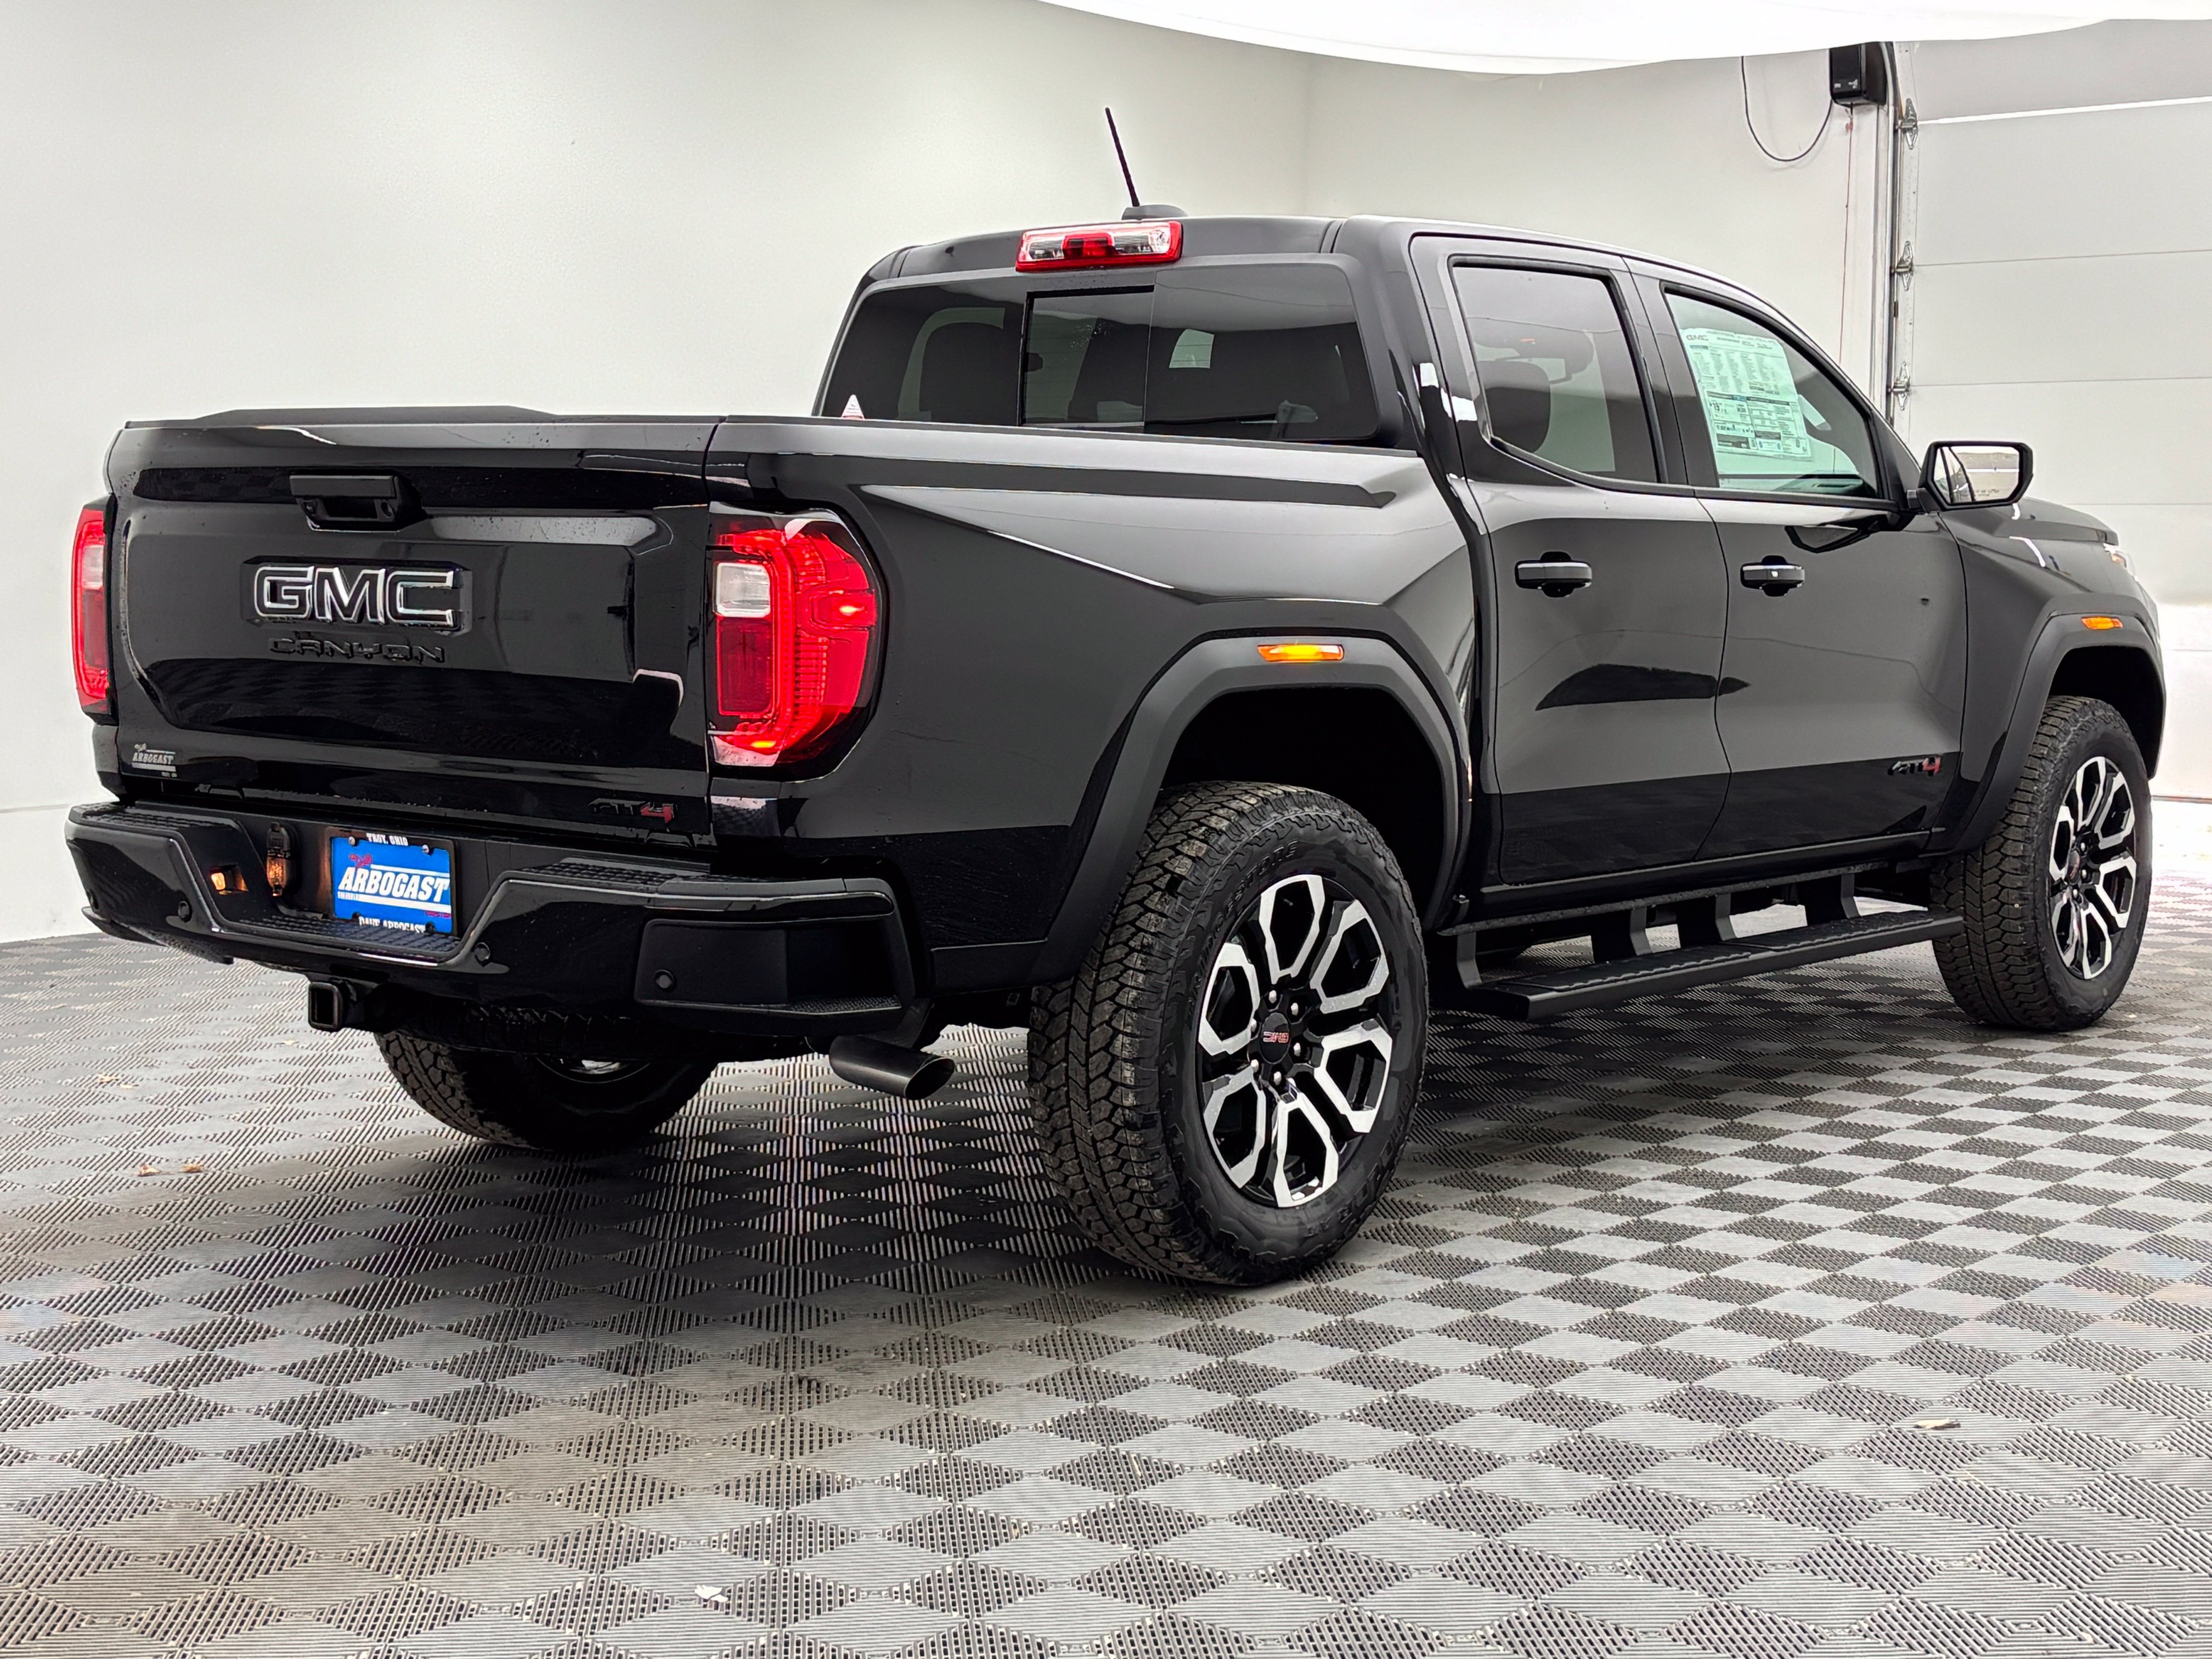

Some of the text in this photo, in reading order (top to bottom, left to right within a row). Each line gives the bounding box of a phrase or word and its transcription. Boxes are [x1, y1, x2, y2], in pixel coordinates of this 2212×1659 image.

[254, 565, 456, 627] GMC
[269, 637, 446, 663] CANYON
[132, 752, 174, 765] ARBOGAST
[1892, 757, 1941, 775] AT4
[389, 835, 409, 847] OHIO
[337, 866, 450, 902] ARBOGAST
